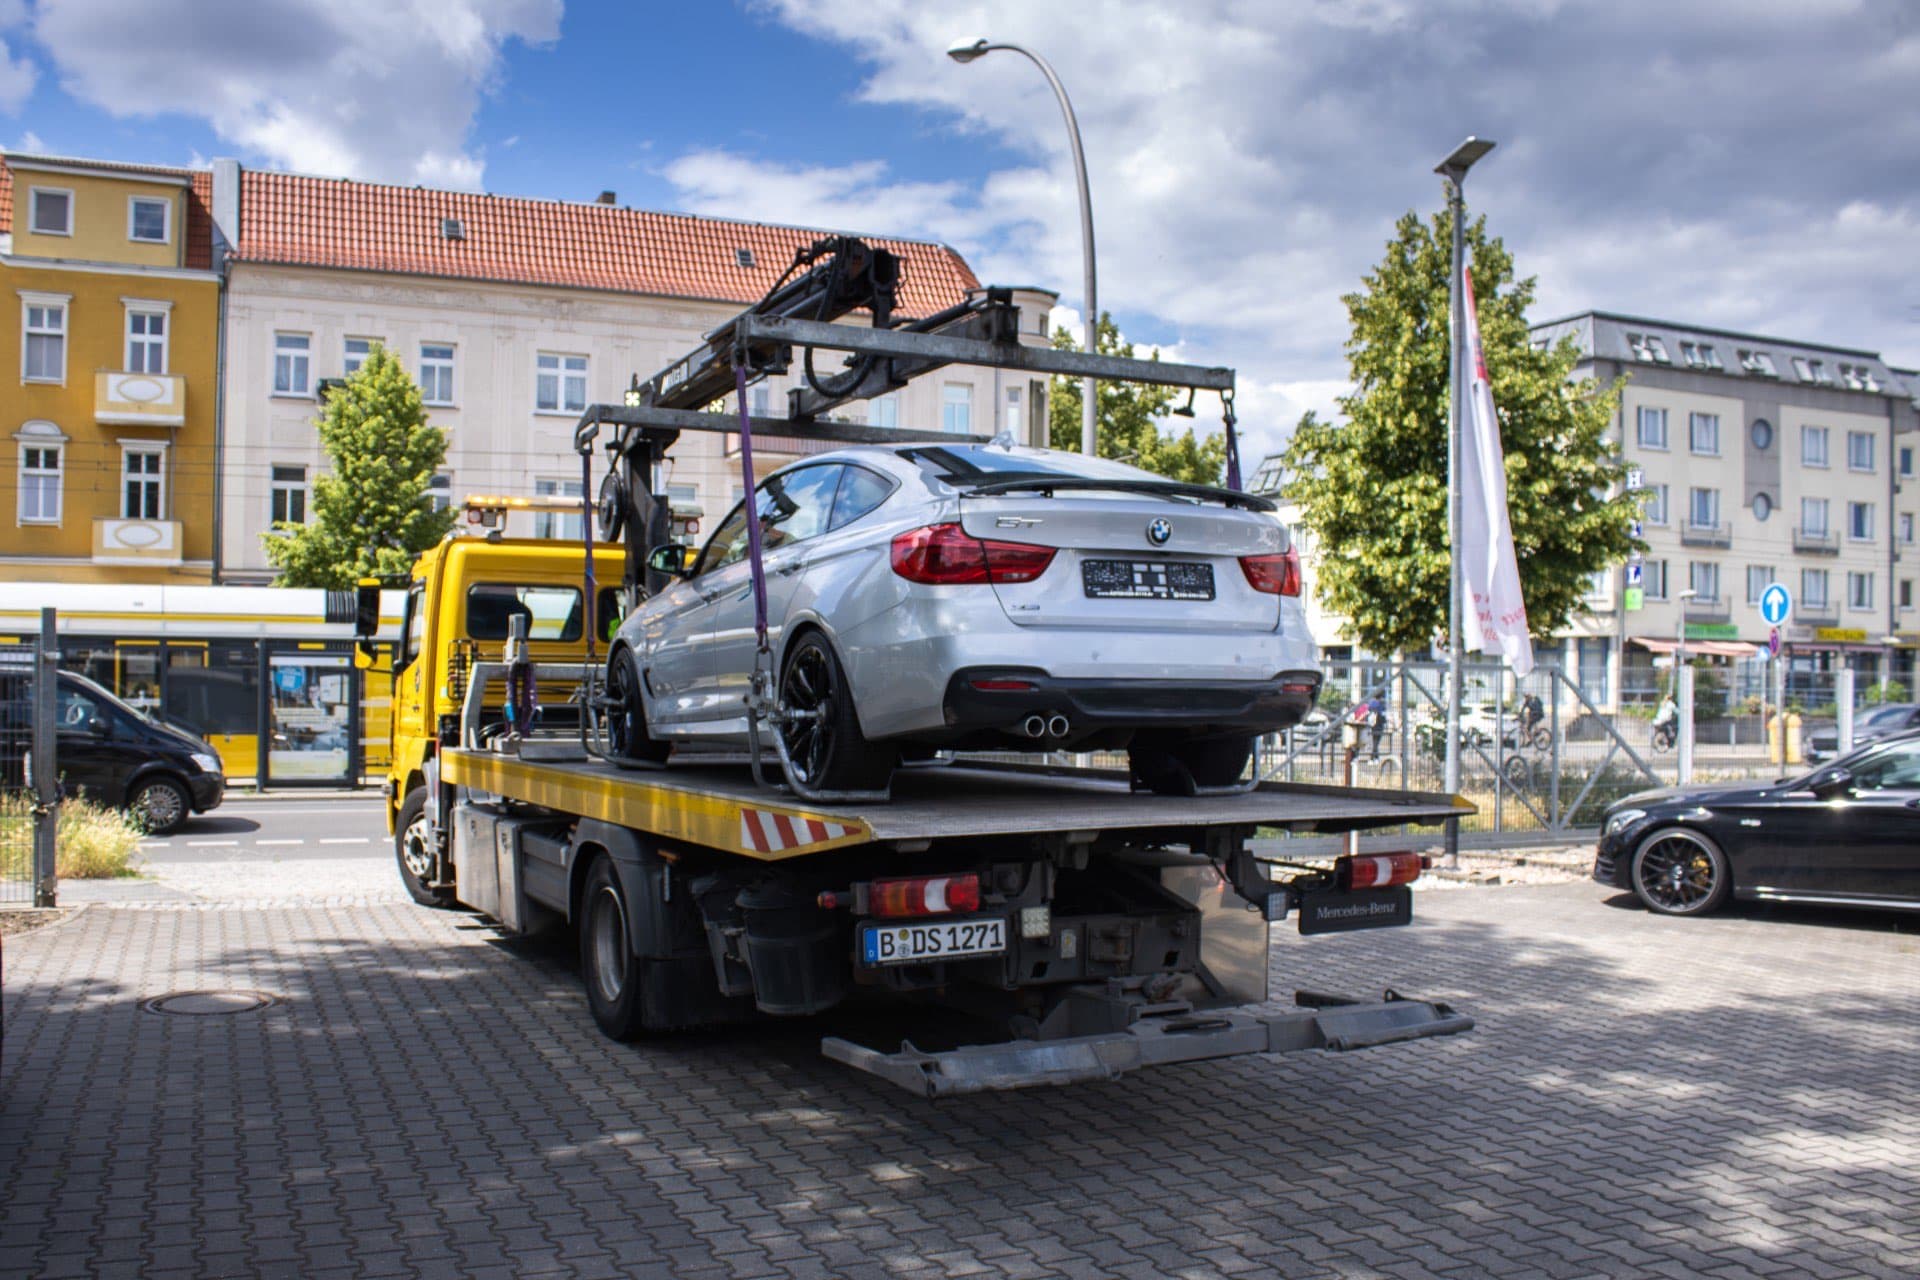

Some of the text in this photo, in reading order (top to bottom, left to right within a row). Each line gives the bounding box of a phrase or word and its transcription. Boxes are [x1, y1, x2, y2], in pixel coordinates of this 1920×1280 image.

[995, 516, 1044, 528] GT
[1317, 902, 1395, 920] Mercedes-Benz
[880, 923, 1003, 957] B DS 1271
